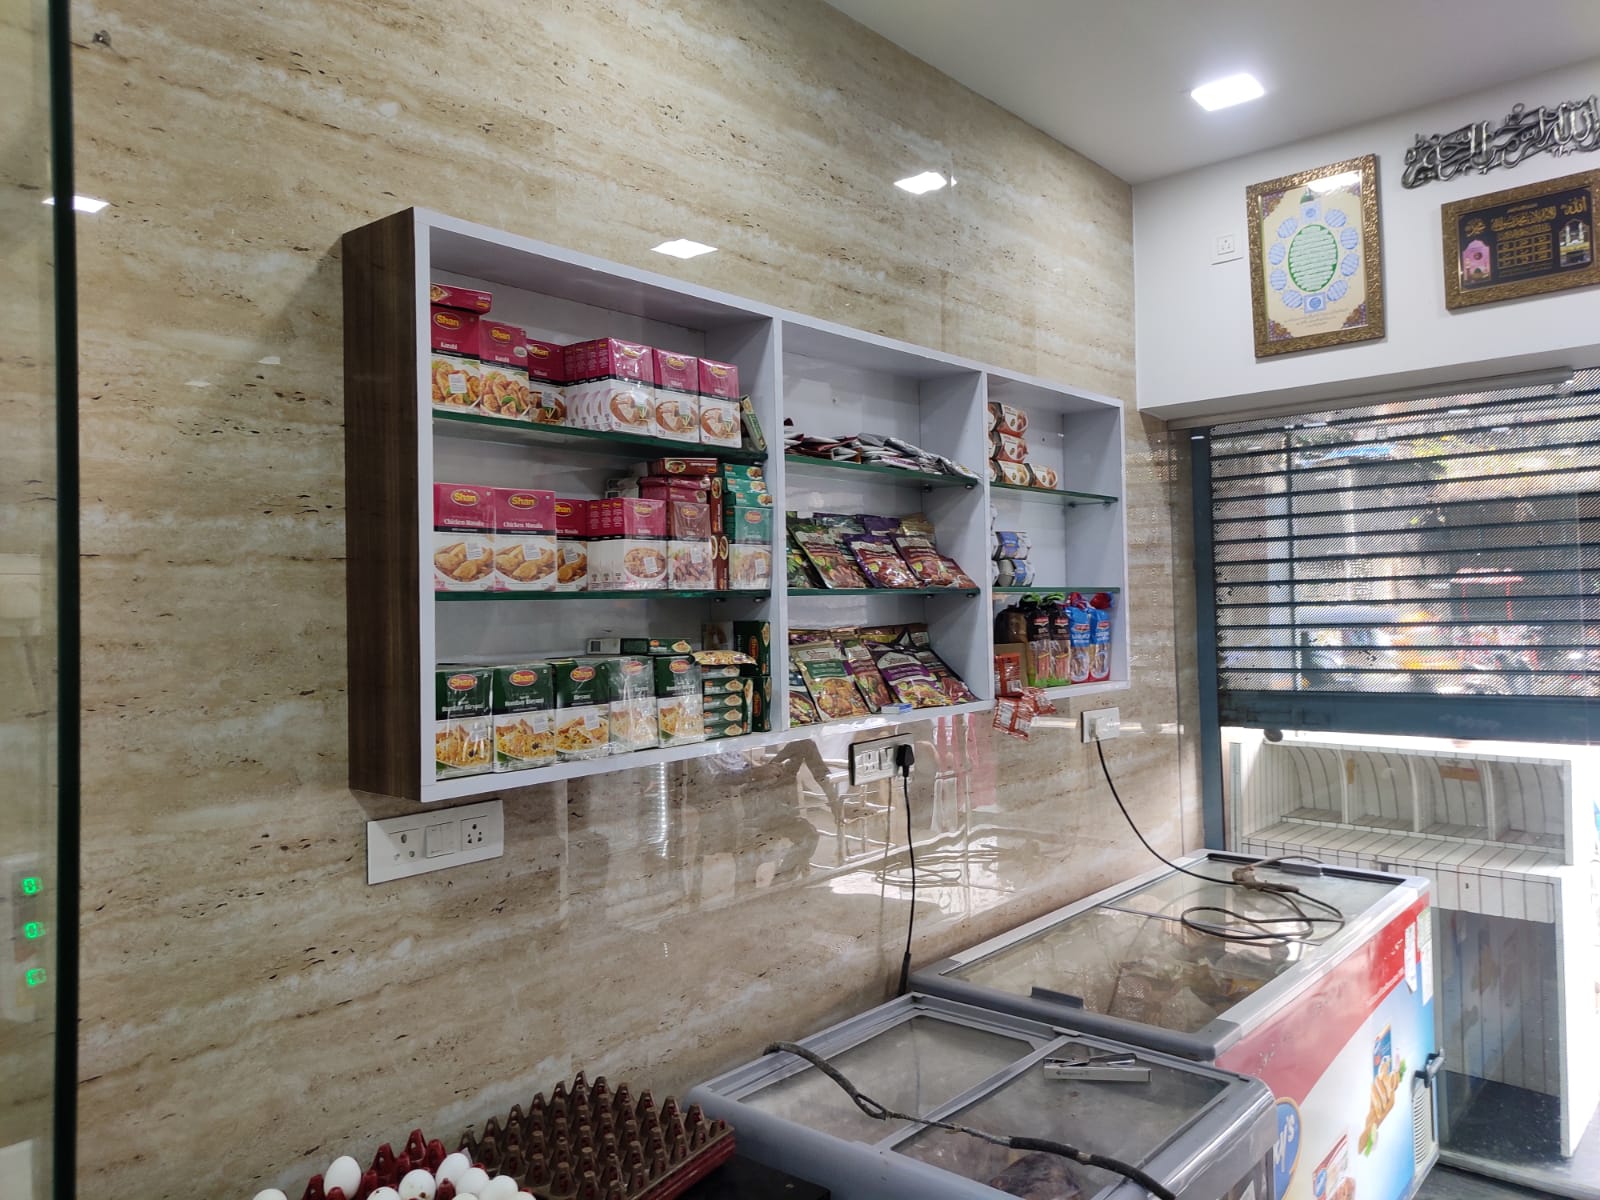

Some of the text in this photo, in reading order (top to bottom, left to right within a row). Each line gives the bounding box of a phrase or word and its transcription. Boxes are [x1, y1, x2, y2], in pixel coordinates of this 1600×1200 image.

[436, 314, 460, 327] Shan
[491, 329, 511, 341] Shan
[453, 492, 477, 502] Shan
[511, 496, 535, 507] Shan
[511, 673, 536, 683] Shan
[572, 670, 594, 679] Shan
[450, 678, 474, 688] Shan
